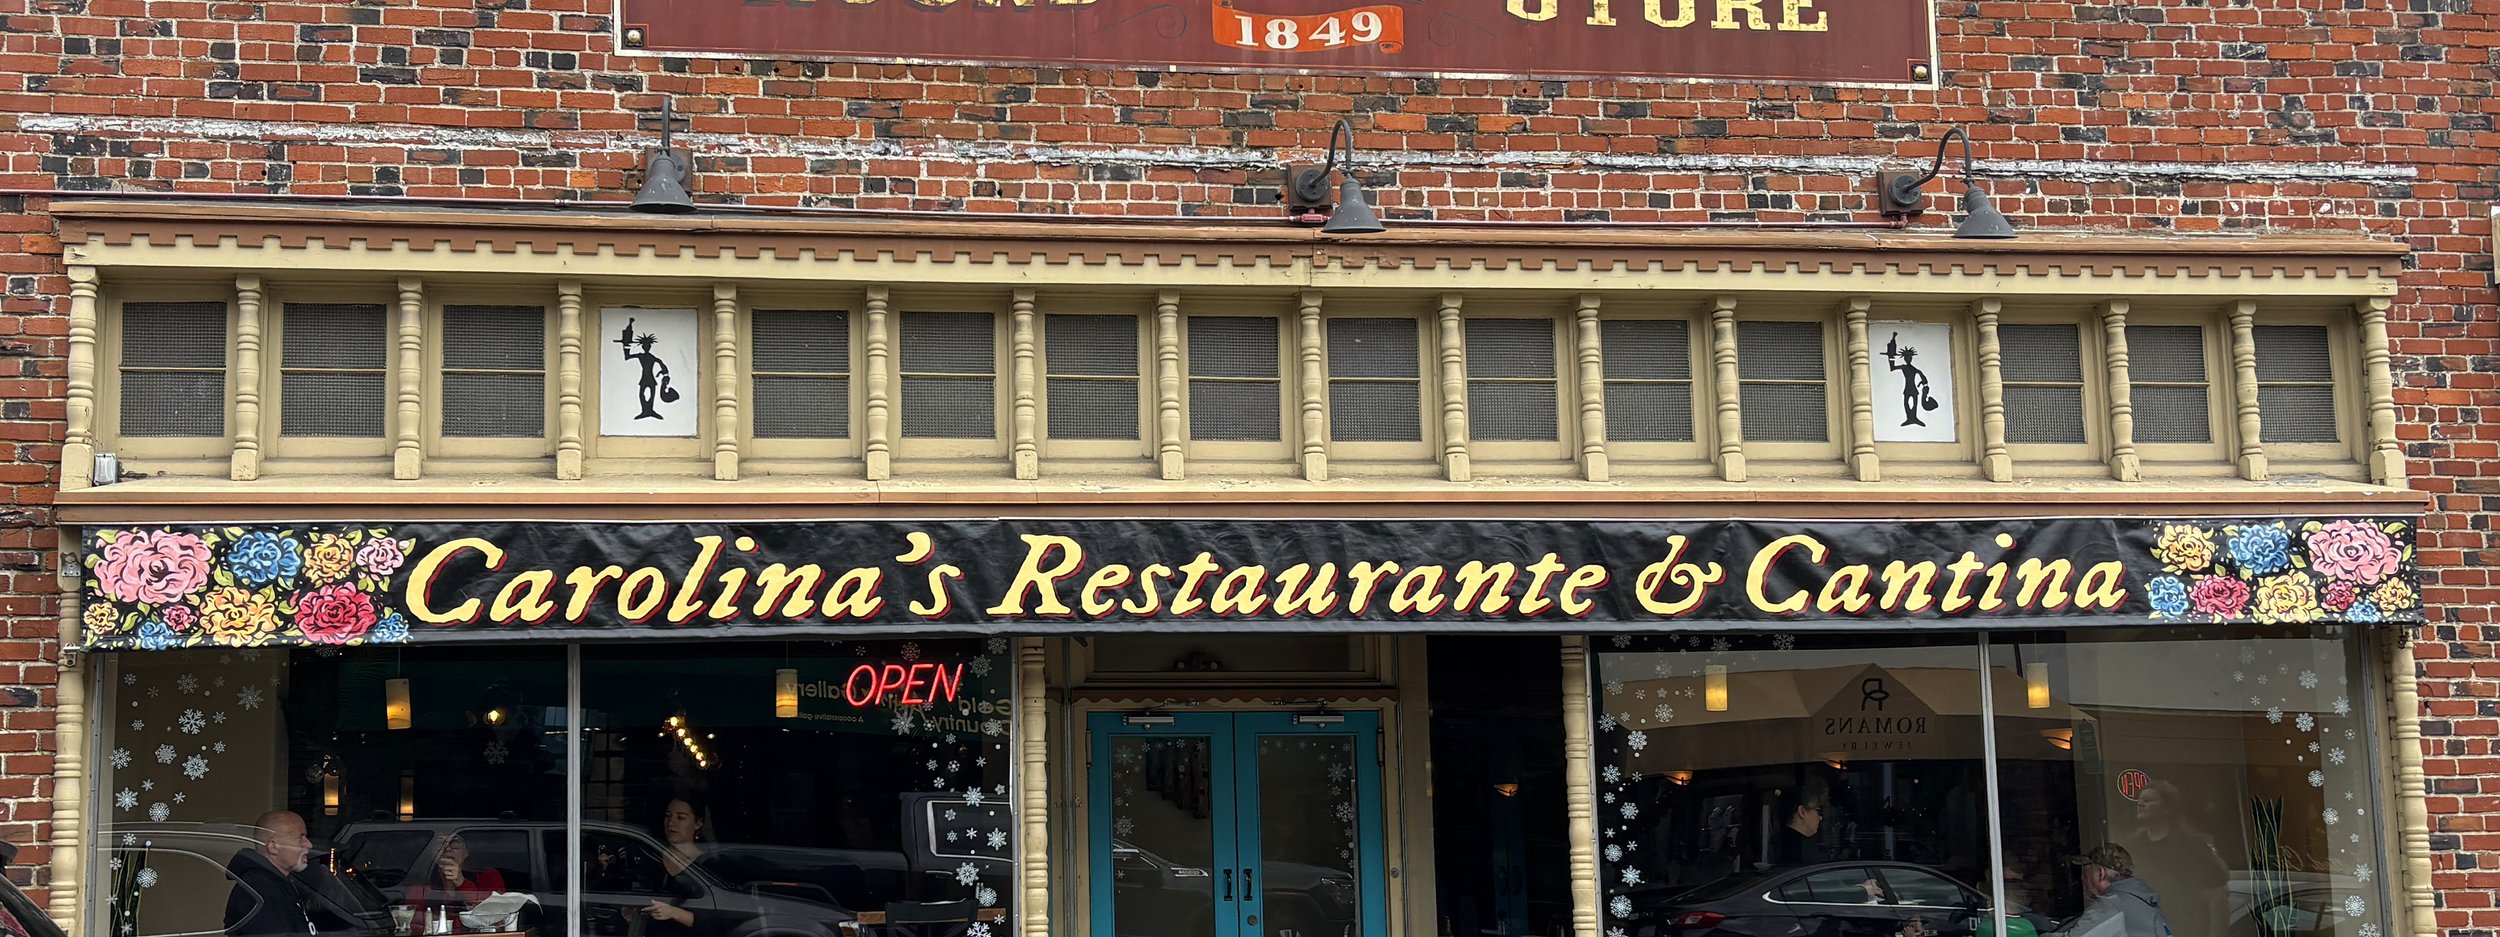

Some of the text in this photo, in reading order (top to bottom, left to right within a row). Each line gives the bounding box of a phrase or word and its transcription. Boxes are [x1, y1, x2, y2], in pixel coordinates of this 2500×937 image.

[1235, 11, 1383, 50] 1849
[404, 531, 2130, 626] Carolina's Restaurante & Cantina
[846, 663, 964, 707] OPEN
